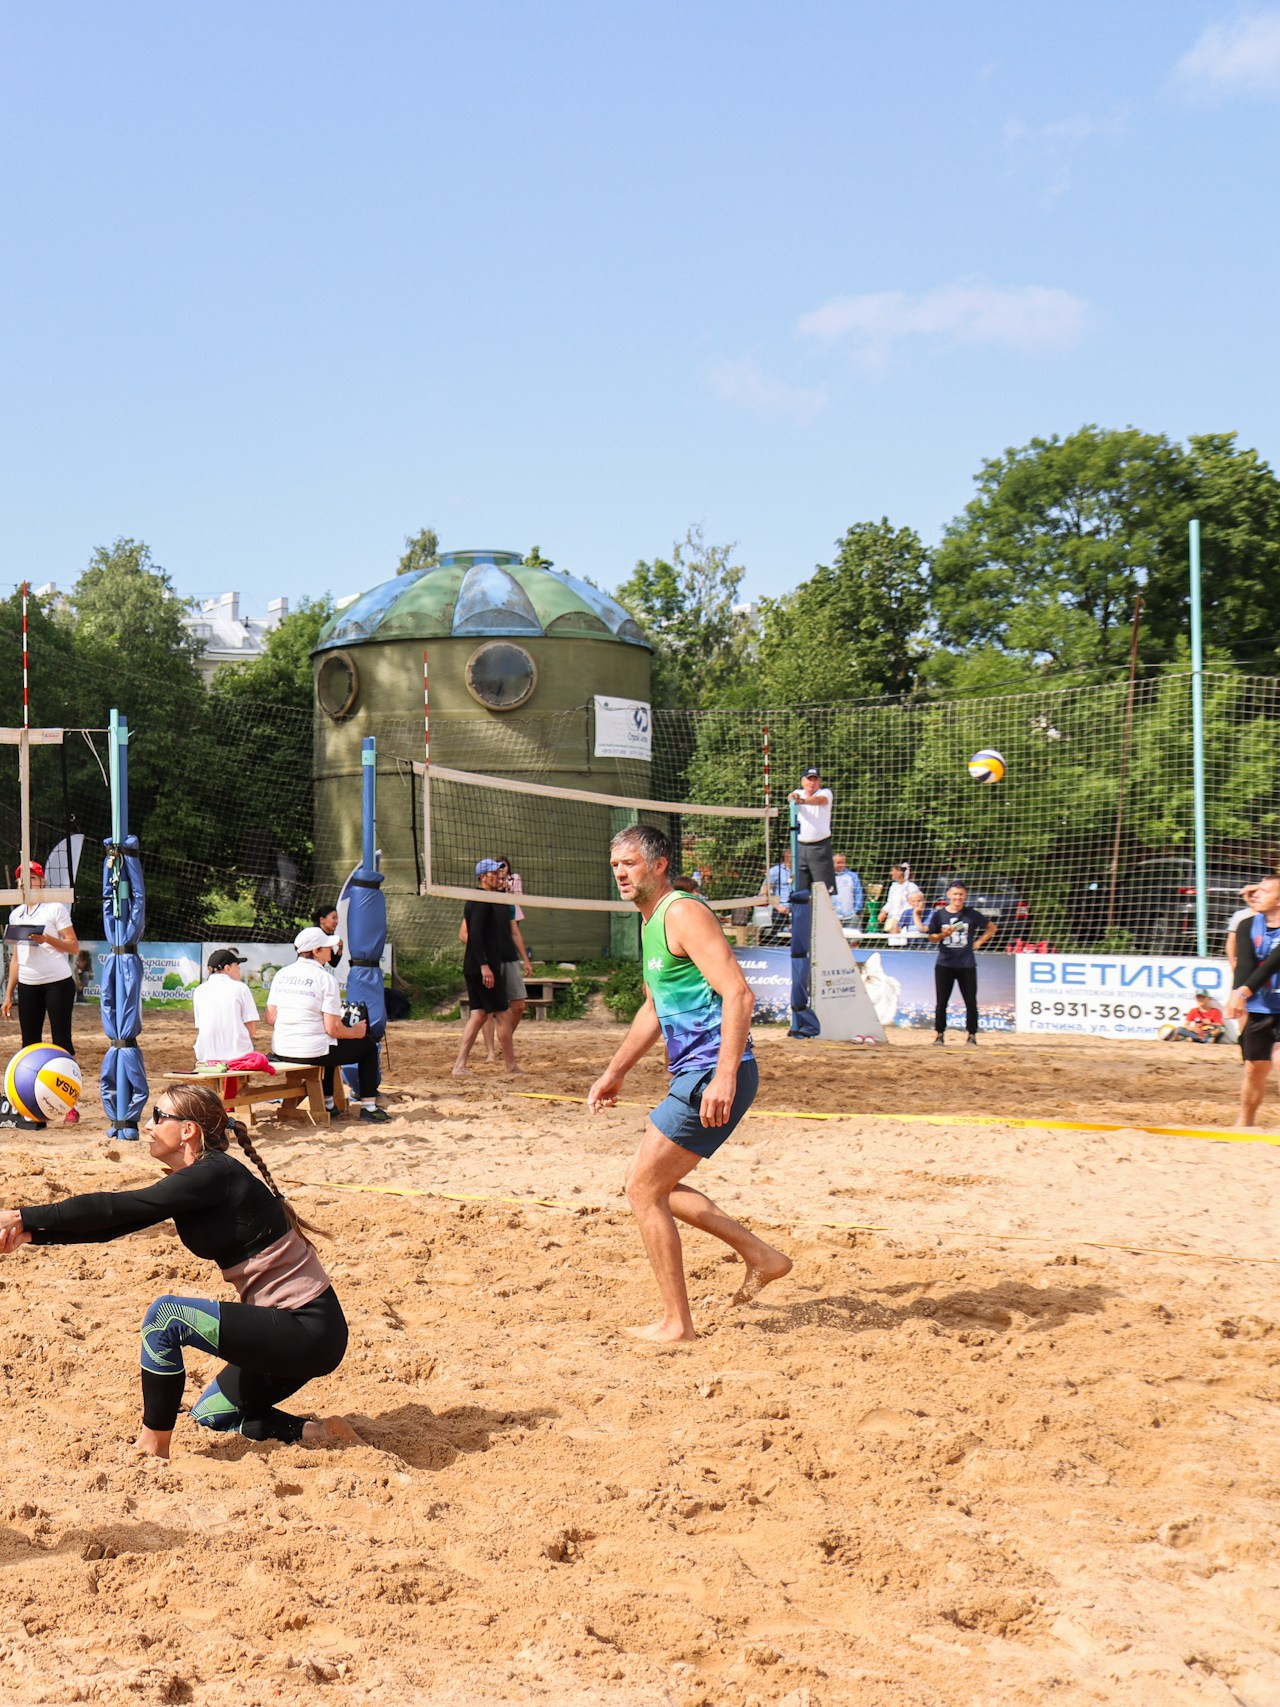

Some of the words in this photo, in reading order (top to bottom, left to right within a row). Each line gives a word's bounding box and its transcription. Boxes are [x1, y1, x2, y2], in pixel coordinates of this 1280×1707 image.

[278, 975, 314, 987] СУДЬЯ
[1030, 961, 1223, 990] ВЕТИКО
[1029, 1020, 1086, 1032] Гатчина,
[1091, 1024, 1110, 1033] ул.
[1114, 1024, 1160, 1034] Филип
